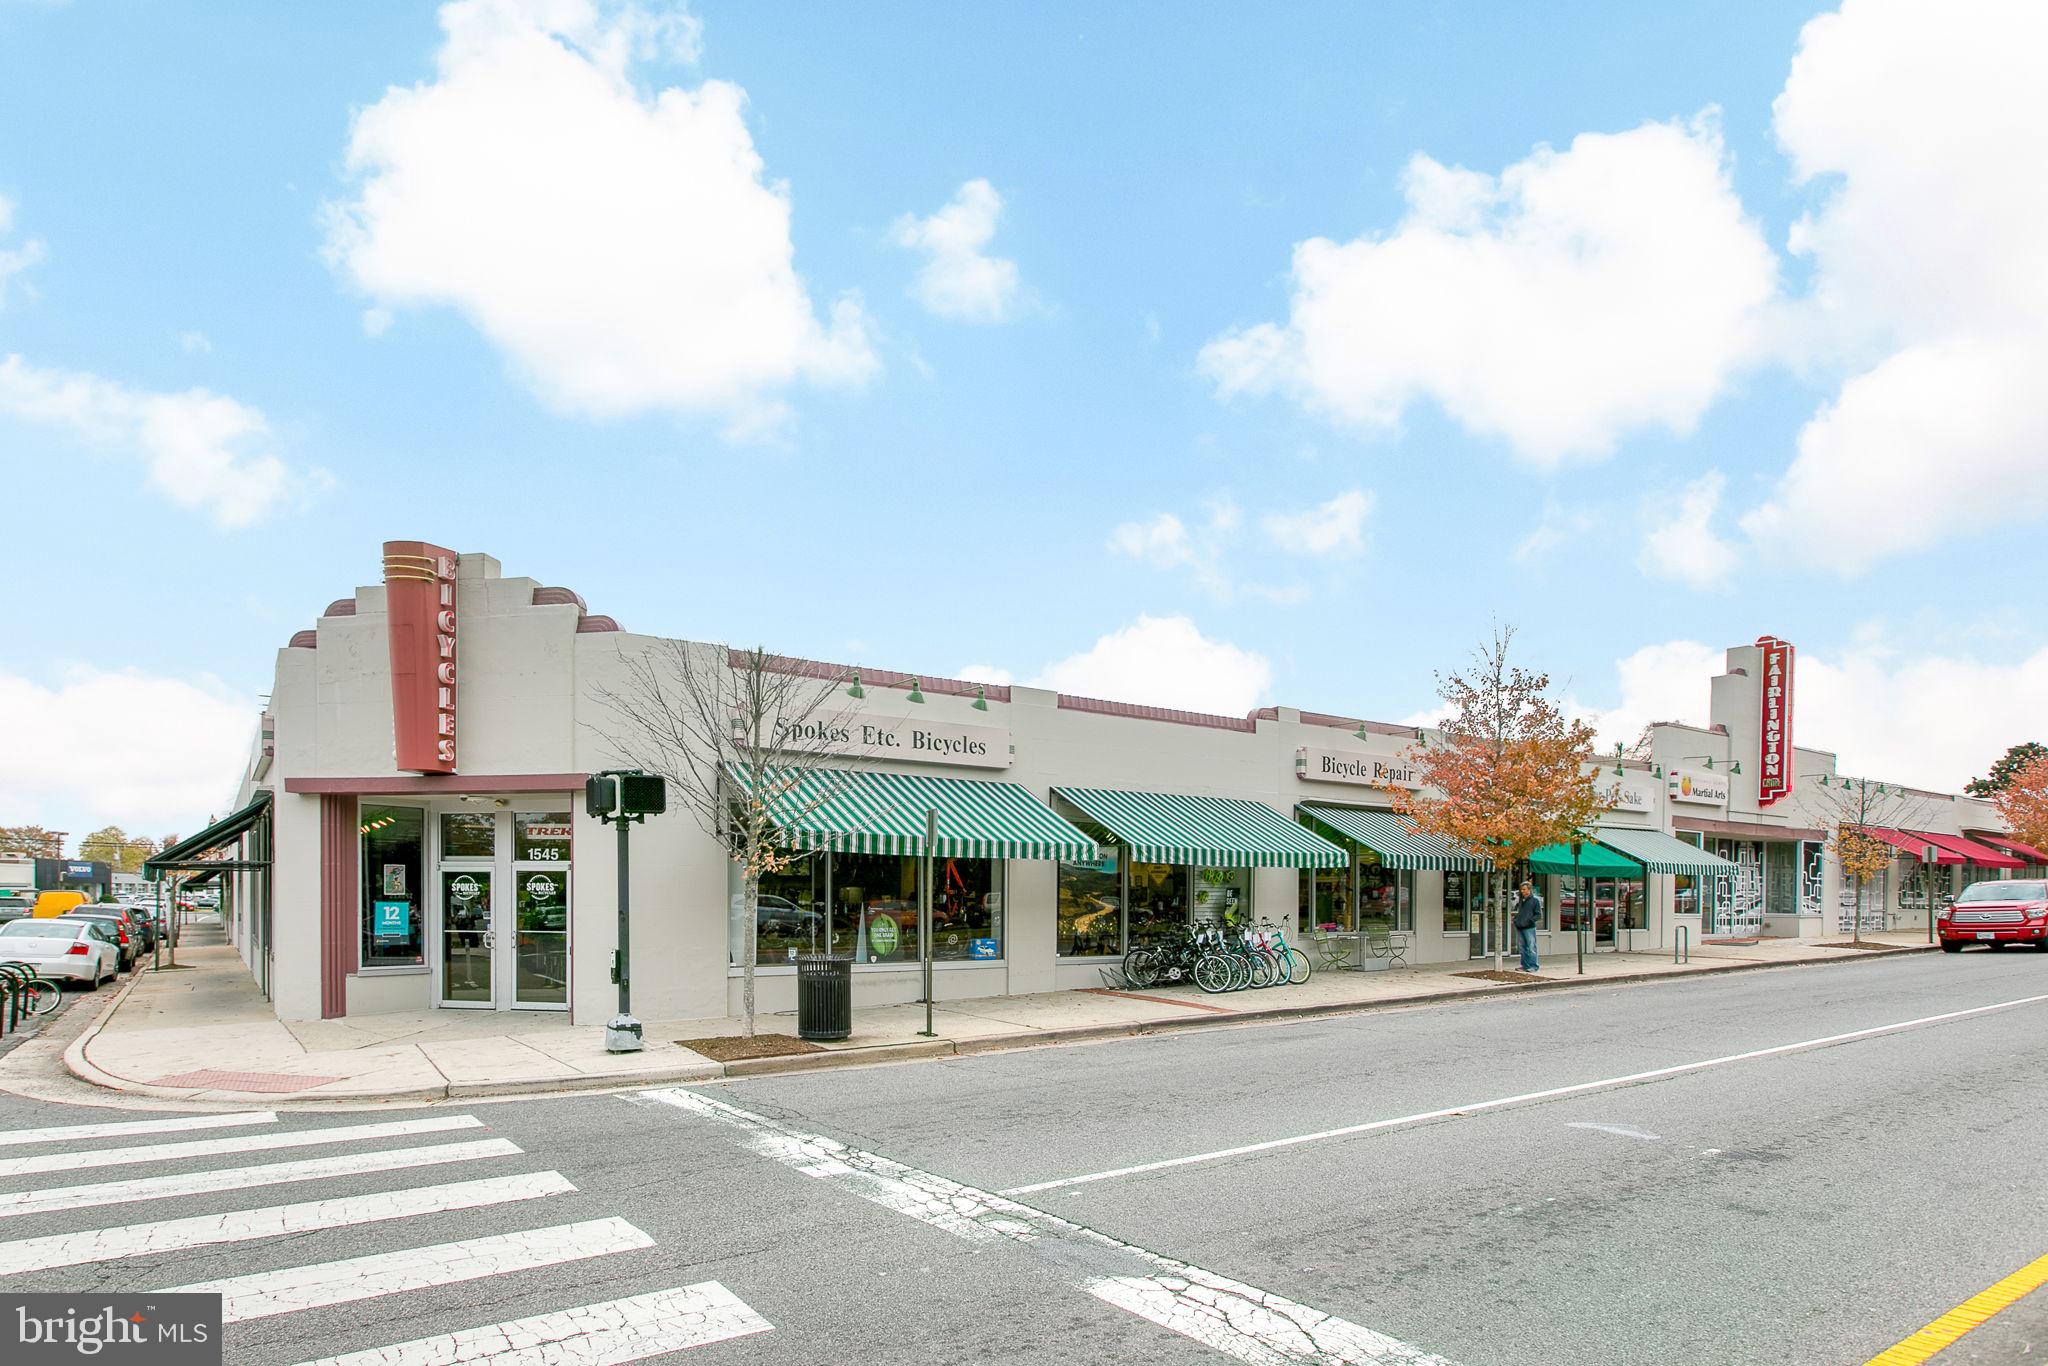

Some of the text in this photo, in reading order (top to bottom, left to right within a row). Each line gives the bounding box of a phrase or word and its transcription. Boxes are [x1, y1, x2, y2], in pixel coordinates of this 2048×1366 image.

[437, 556, 456, 762] BICYCLES
[1765, 653, 1782, 776] FAIRLINGTON
[775, 716, 987, 756] Spokes Etc. Bicycles
[1321, 755, 1416, 783] Bicycle Repair
[1624, 790, 1642, 805] Sake
[1692, 787, 1726, 800] Martial Arts
[526, 826, 572, 836] TREK
[527, 848, 559, 861] 1545
[68, 865, 92, 873] VOLVO
[451, 882, 479, 892] SPOKES
[526, 882, 555, 891] SPOKES
[383, 906, 400, 920] 12
